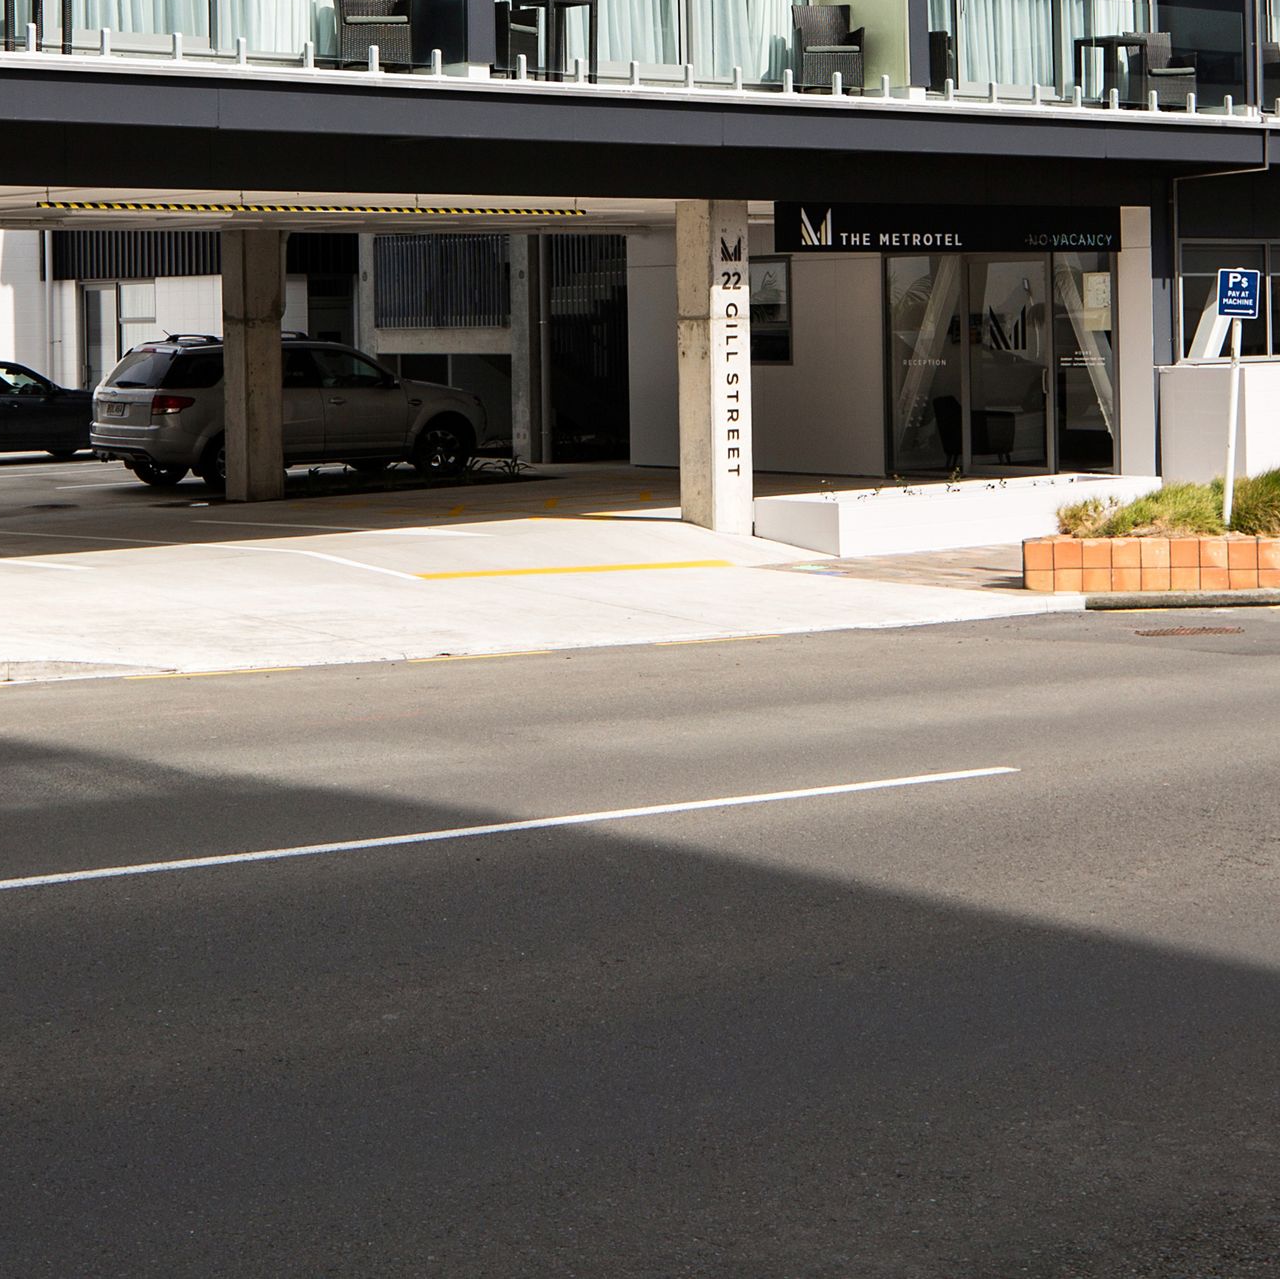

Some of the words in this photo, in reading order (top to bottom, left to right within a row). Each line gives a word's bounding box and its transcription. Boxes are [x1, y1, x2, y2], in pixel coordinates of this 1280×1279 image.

[840, 233, 871, 246] THE
[880, 233, 963, 246] METROTEL
[1052, 233, 1113, 247] VACANCY
[722, 271, 741, 290] 22
[1227, 290, 1240, 298] PAY
[1222, 298, 1254, 306] MACHINE
[725, 302, 739, 362] GILL
[902, 359, 947, 367] RECEPTION
[726, 372, 740, 477] STREET
